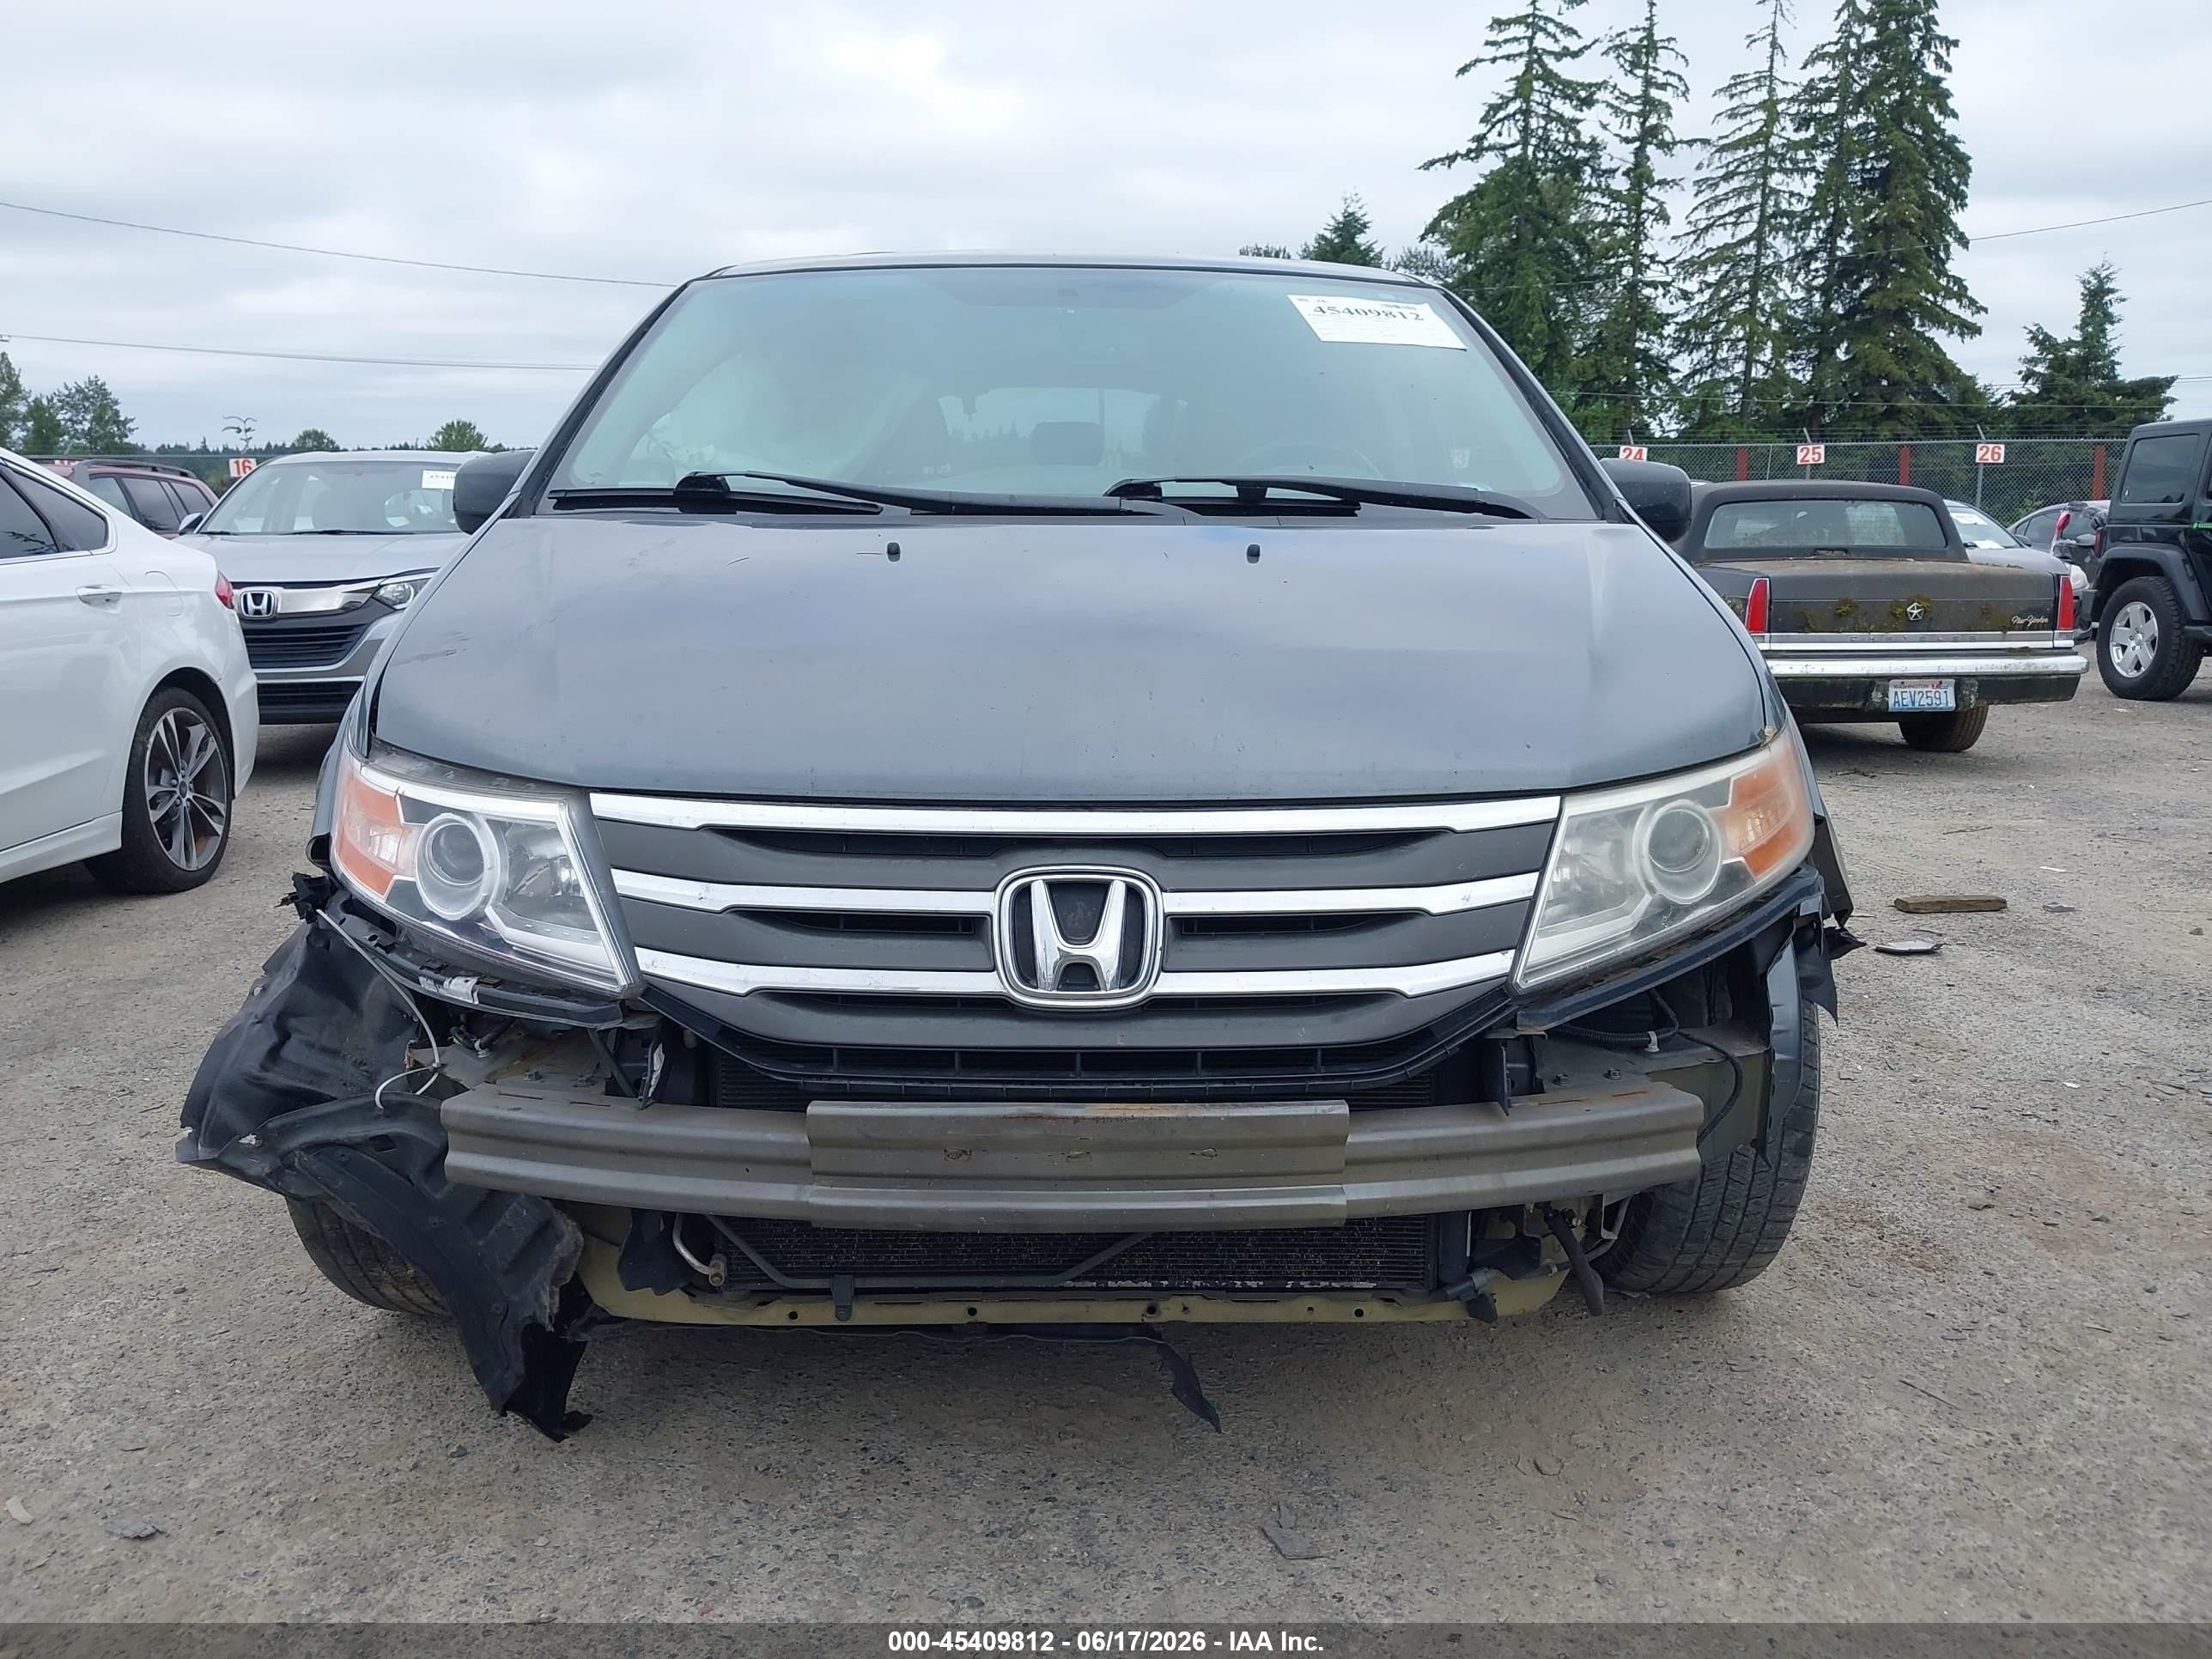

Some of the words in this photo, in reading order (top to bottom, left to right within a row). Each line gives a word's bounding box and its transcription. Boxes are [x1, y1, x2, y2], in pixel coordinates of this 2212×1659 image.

[1314, 306, 1424, 320] 45409812
[1800, 447, 1821, 463] 25
[1978, 445, 2002, 461] 26
[234, 459, 252, 475] 16
[1893, 690, 1949, 707] AEV2591
